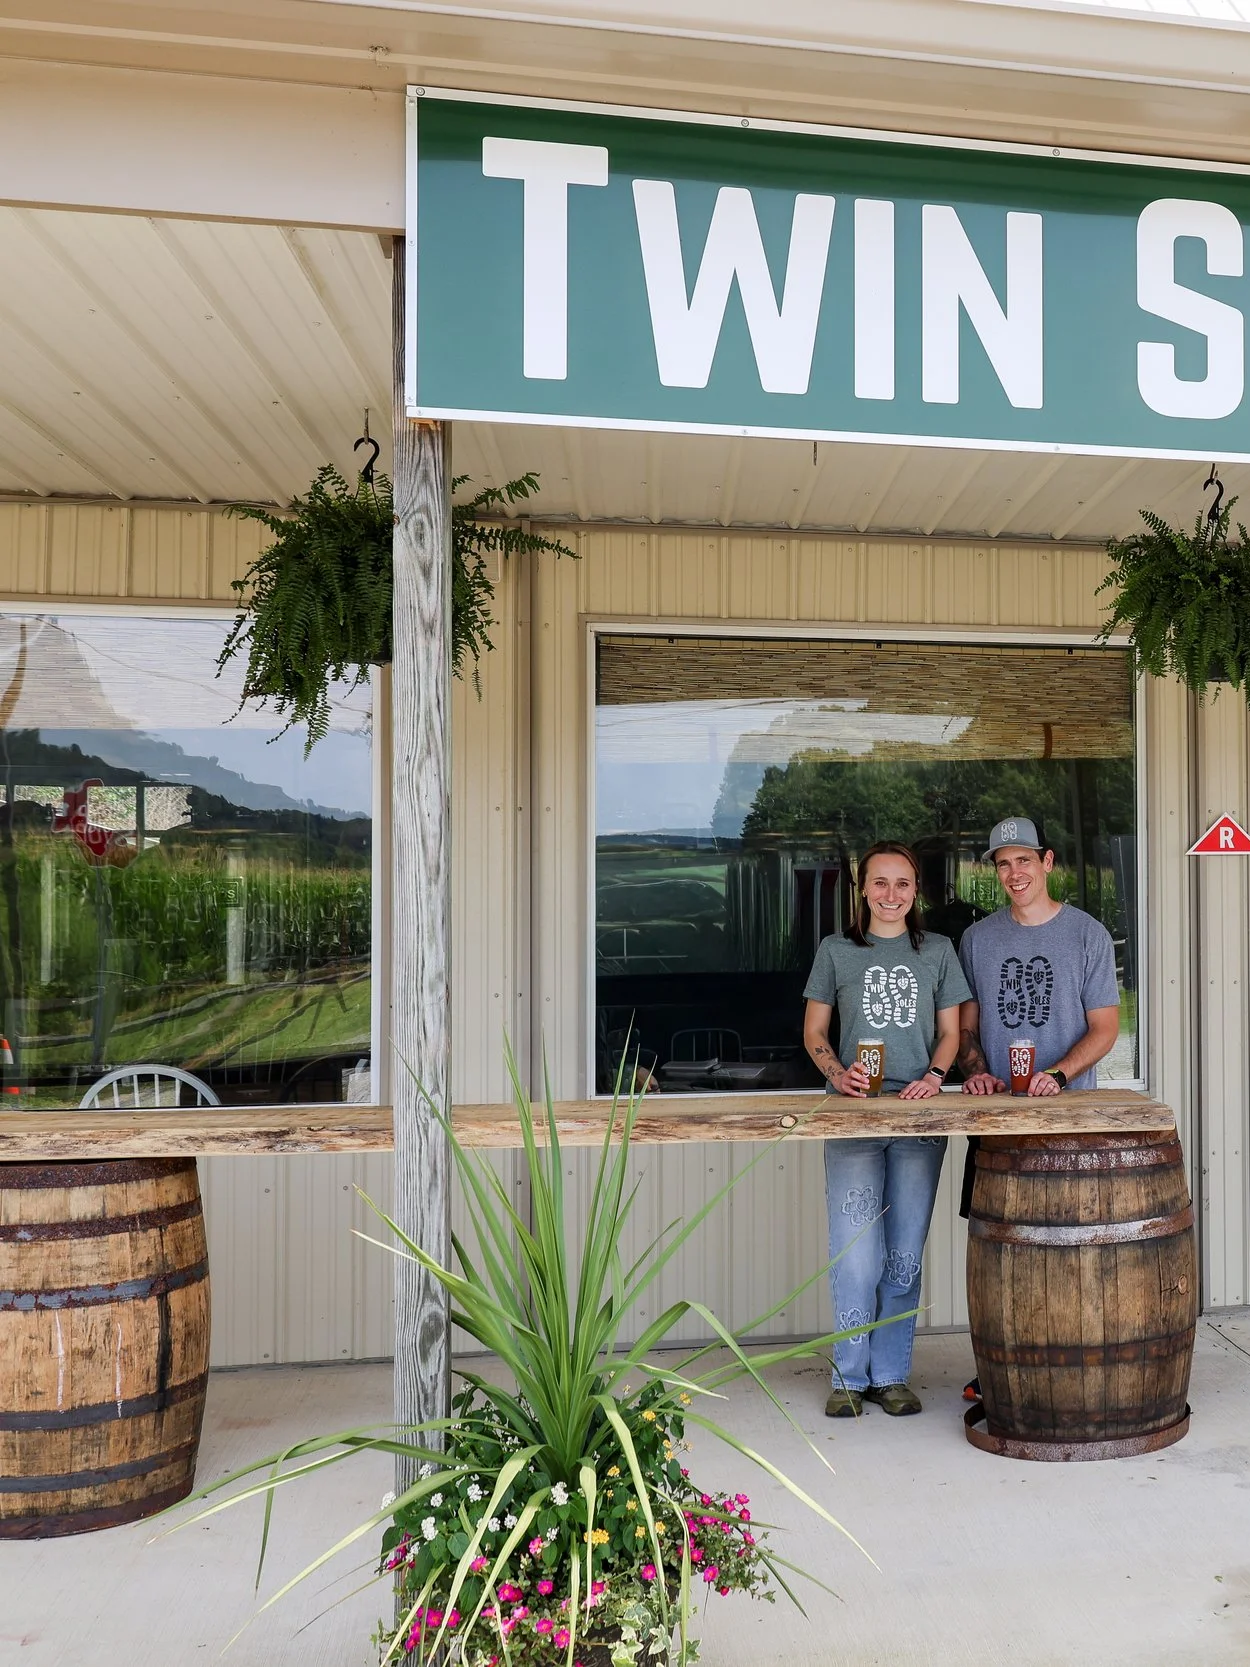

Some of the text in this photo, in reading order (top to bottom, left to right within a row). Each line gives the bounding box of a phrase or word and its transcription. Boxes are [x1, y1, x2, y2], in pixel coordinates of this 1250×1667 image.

[482, 136, 1043, 410] TWIN
[1220, 826, 1235, 849] R
[895, 998, 917, 1008] SOLES
[1030, 995, 1051, 1006] SOLES
